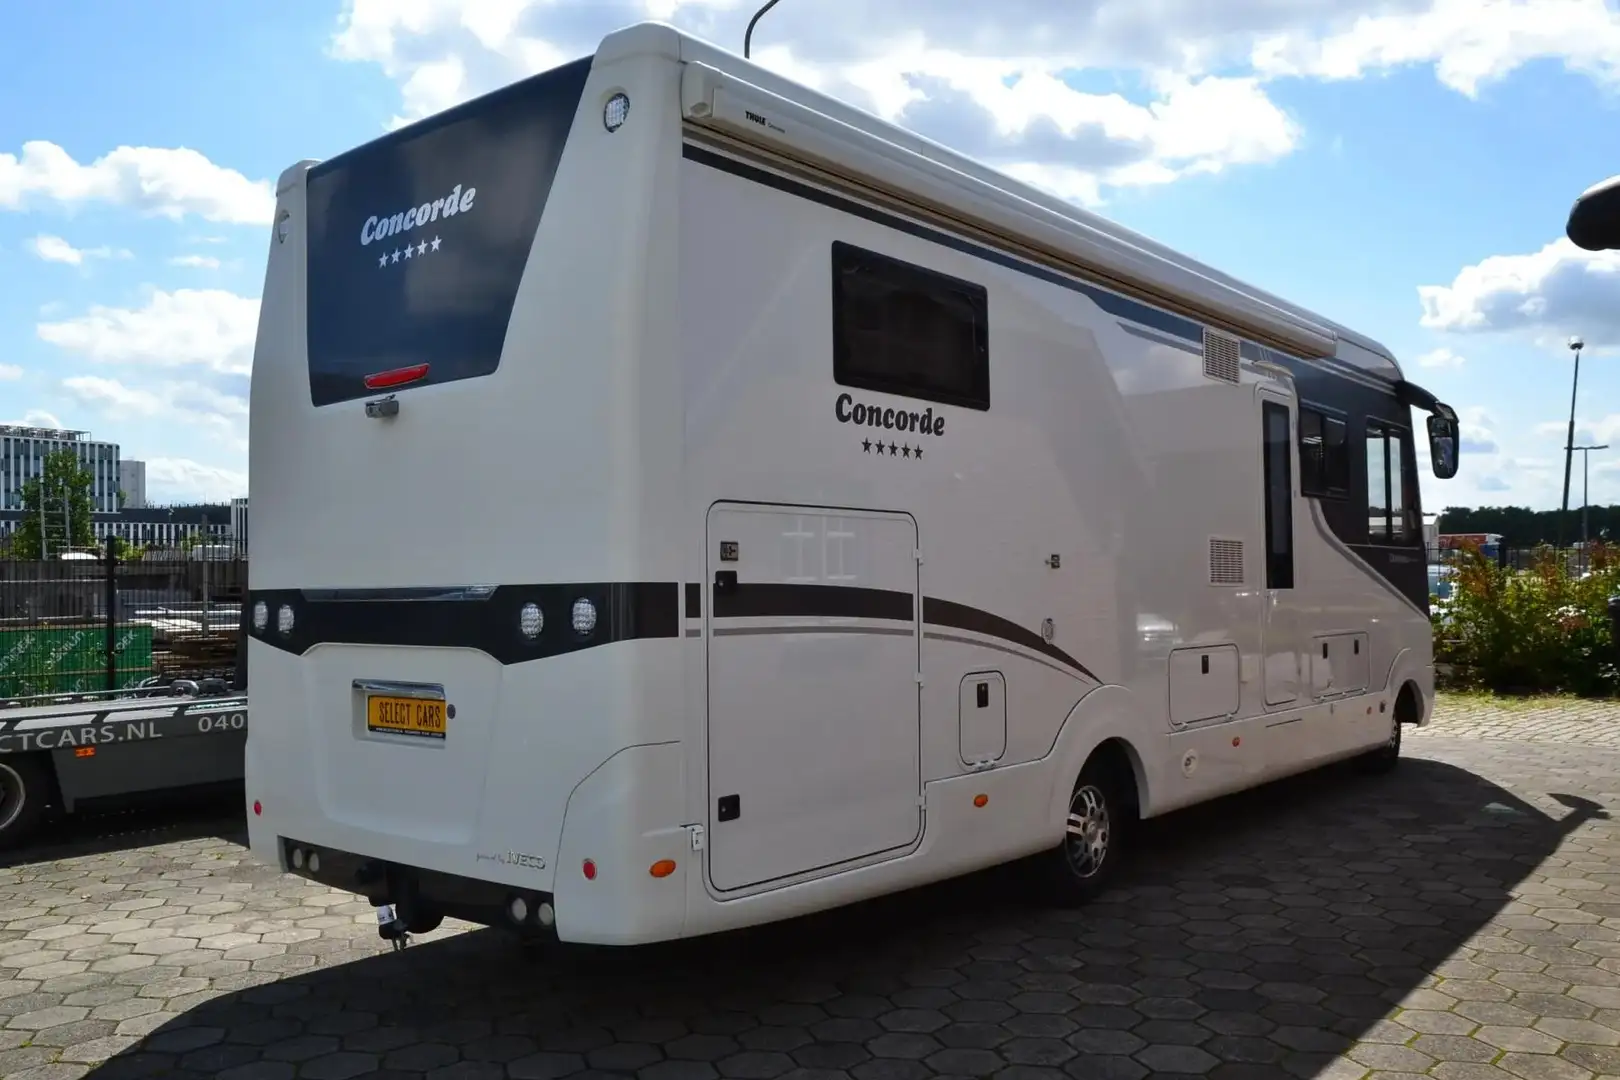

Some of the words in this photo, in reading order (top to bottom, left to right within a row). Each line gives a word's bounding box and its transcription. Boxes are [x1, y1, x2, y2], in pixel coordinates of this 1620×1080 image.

[745, 110, 766, 126] THULE
[360, 184, 477, 246] Concorde
[835, 393, 945, 437] Concorde
[198, 713, 245, 732] 040
[379, 701, 412, 725] SELECT
[416, 703, 441, 729] CARS
